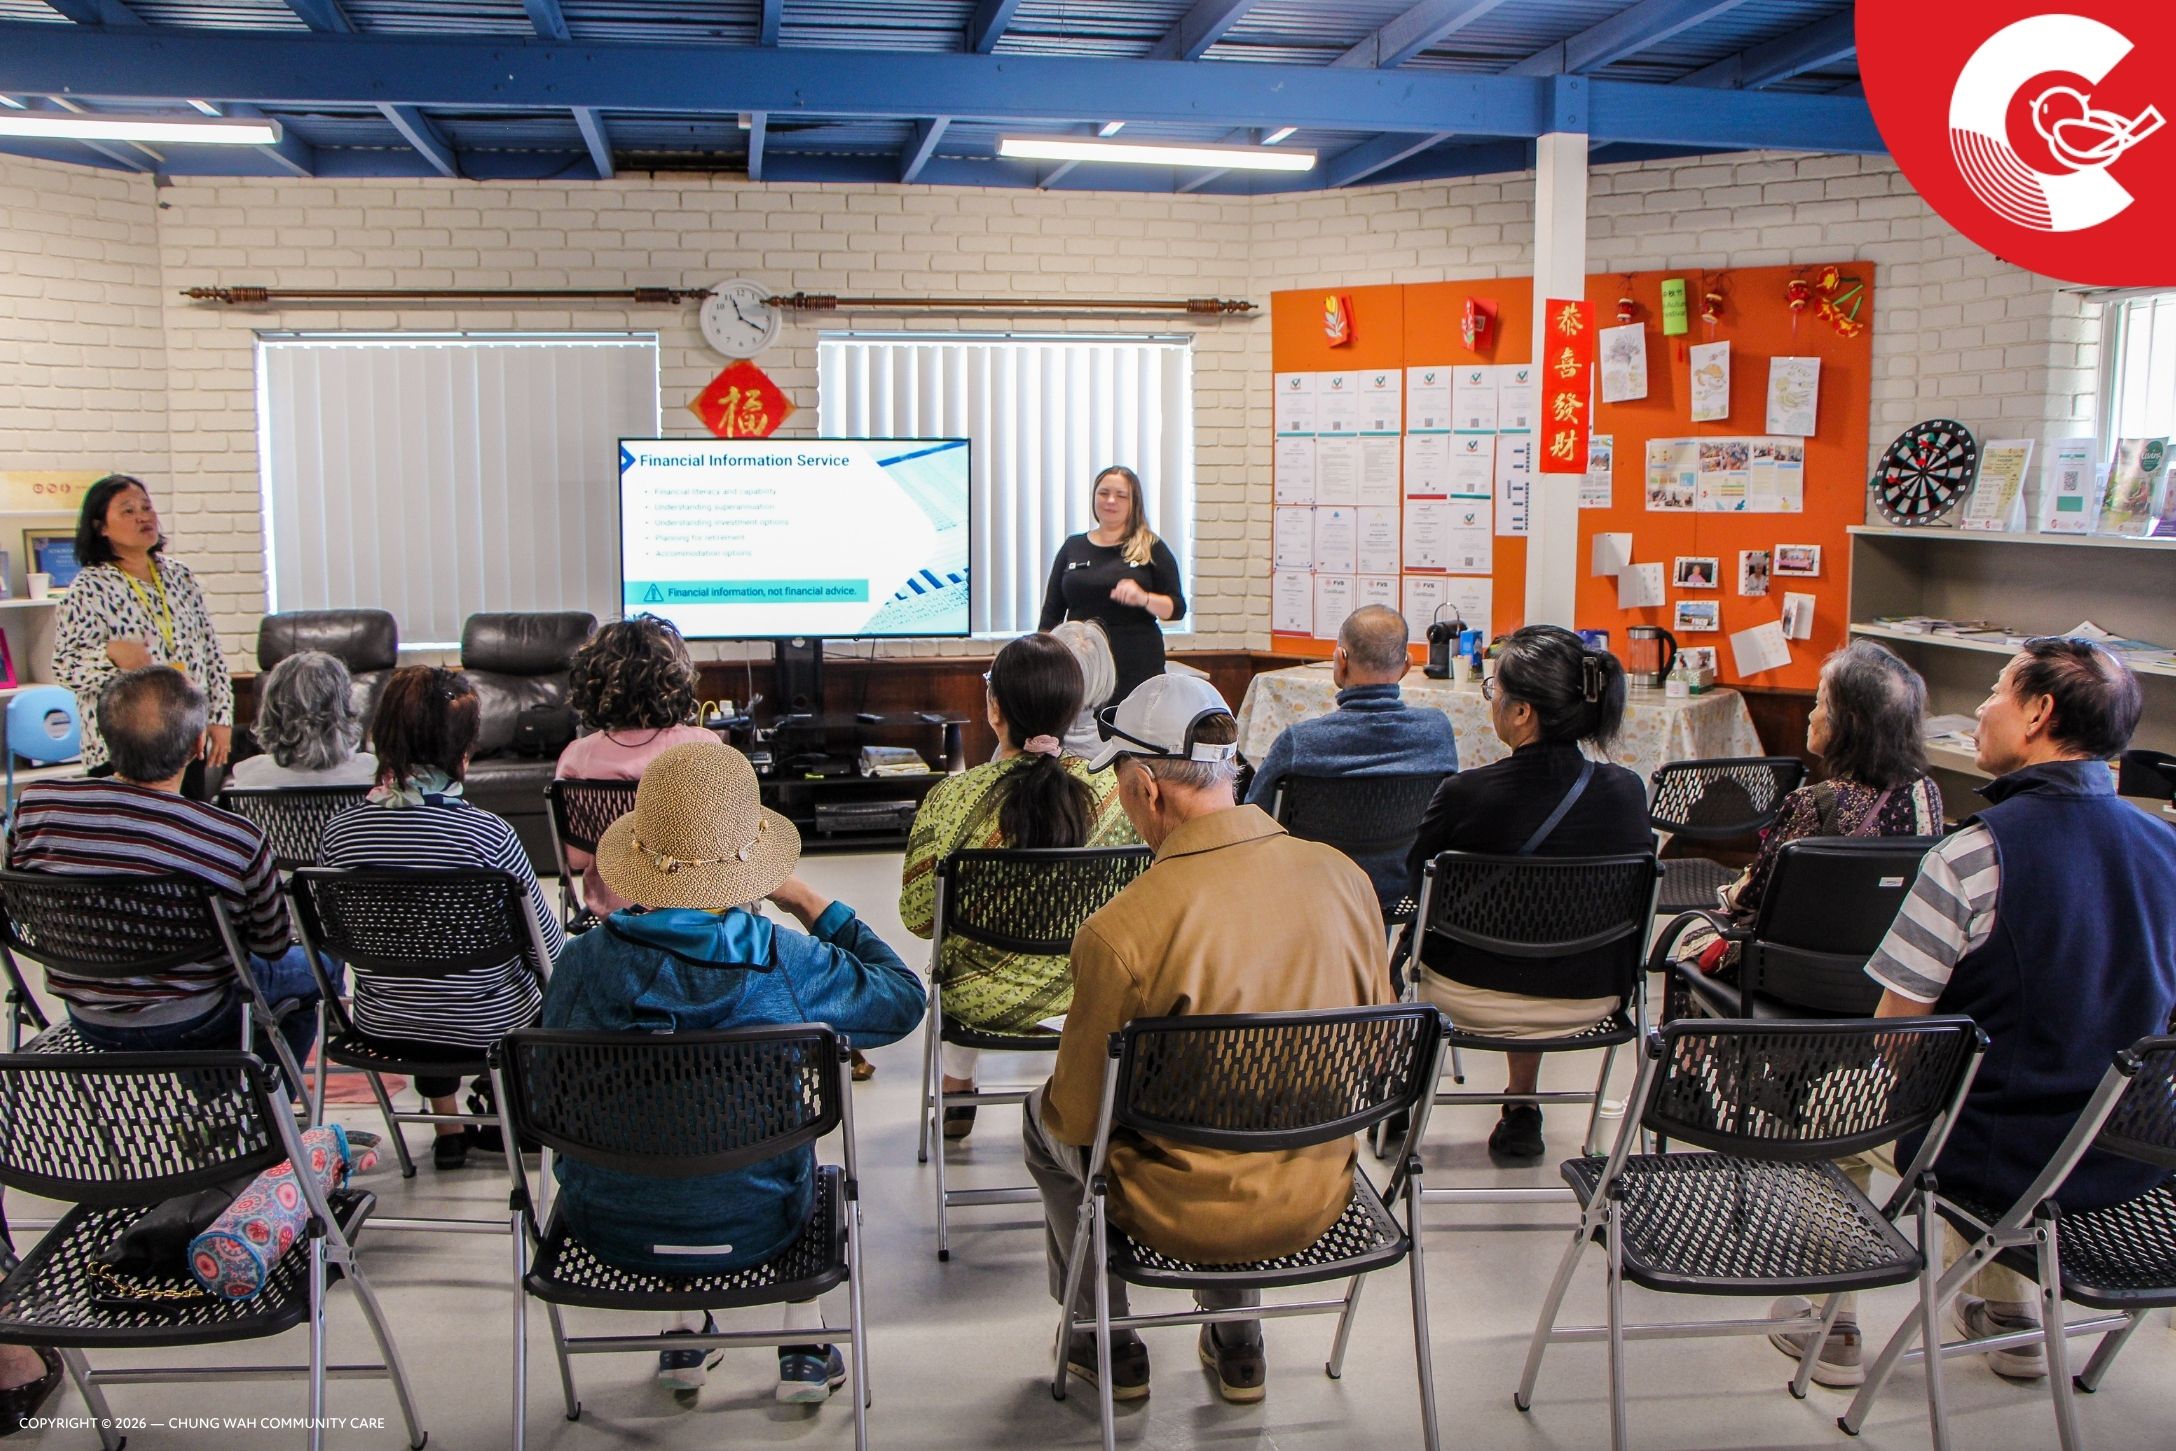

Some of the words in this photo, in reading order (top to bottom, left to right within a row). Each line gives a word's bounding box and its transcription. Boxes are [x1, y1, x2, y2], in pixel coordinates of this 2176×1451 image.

[1550, 302, 1584, 461] 恭喜發財
[718, 386, 769, 438] 福
[640, 454, 704, 467] Financial
[709, 454, 793, 467] Information
[797, 454, 850, 467] Service
[654, 503, 712, 512] Understanding
[654, 519, 712, 527] Understanding
[668, 588, 709, 597] Financial
[711, 587, 766, 598] information,
[768, 587, 783, 596] not
[785, 586, 823, 596] financial
[825, 586, 857, 596] advice.
